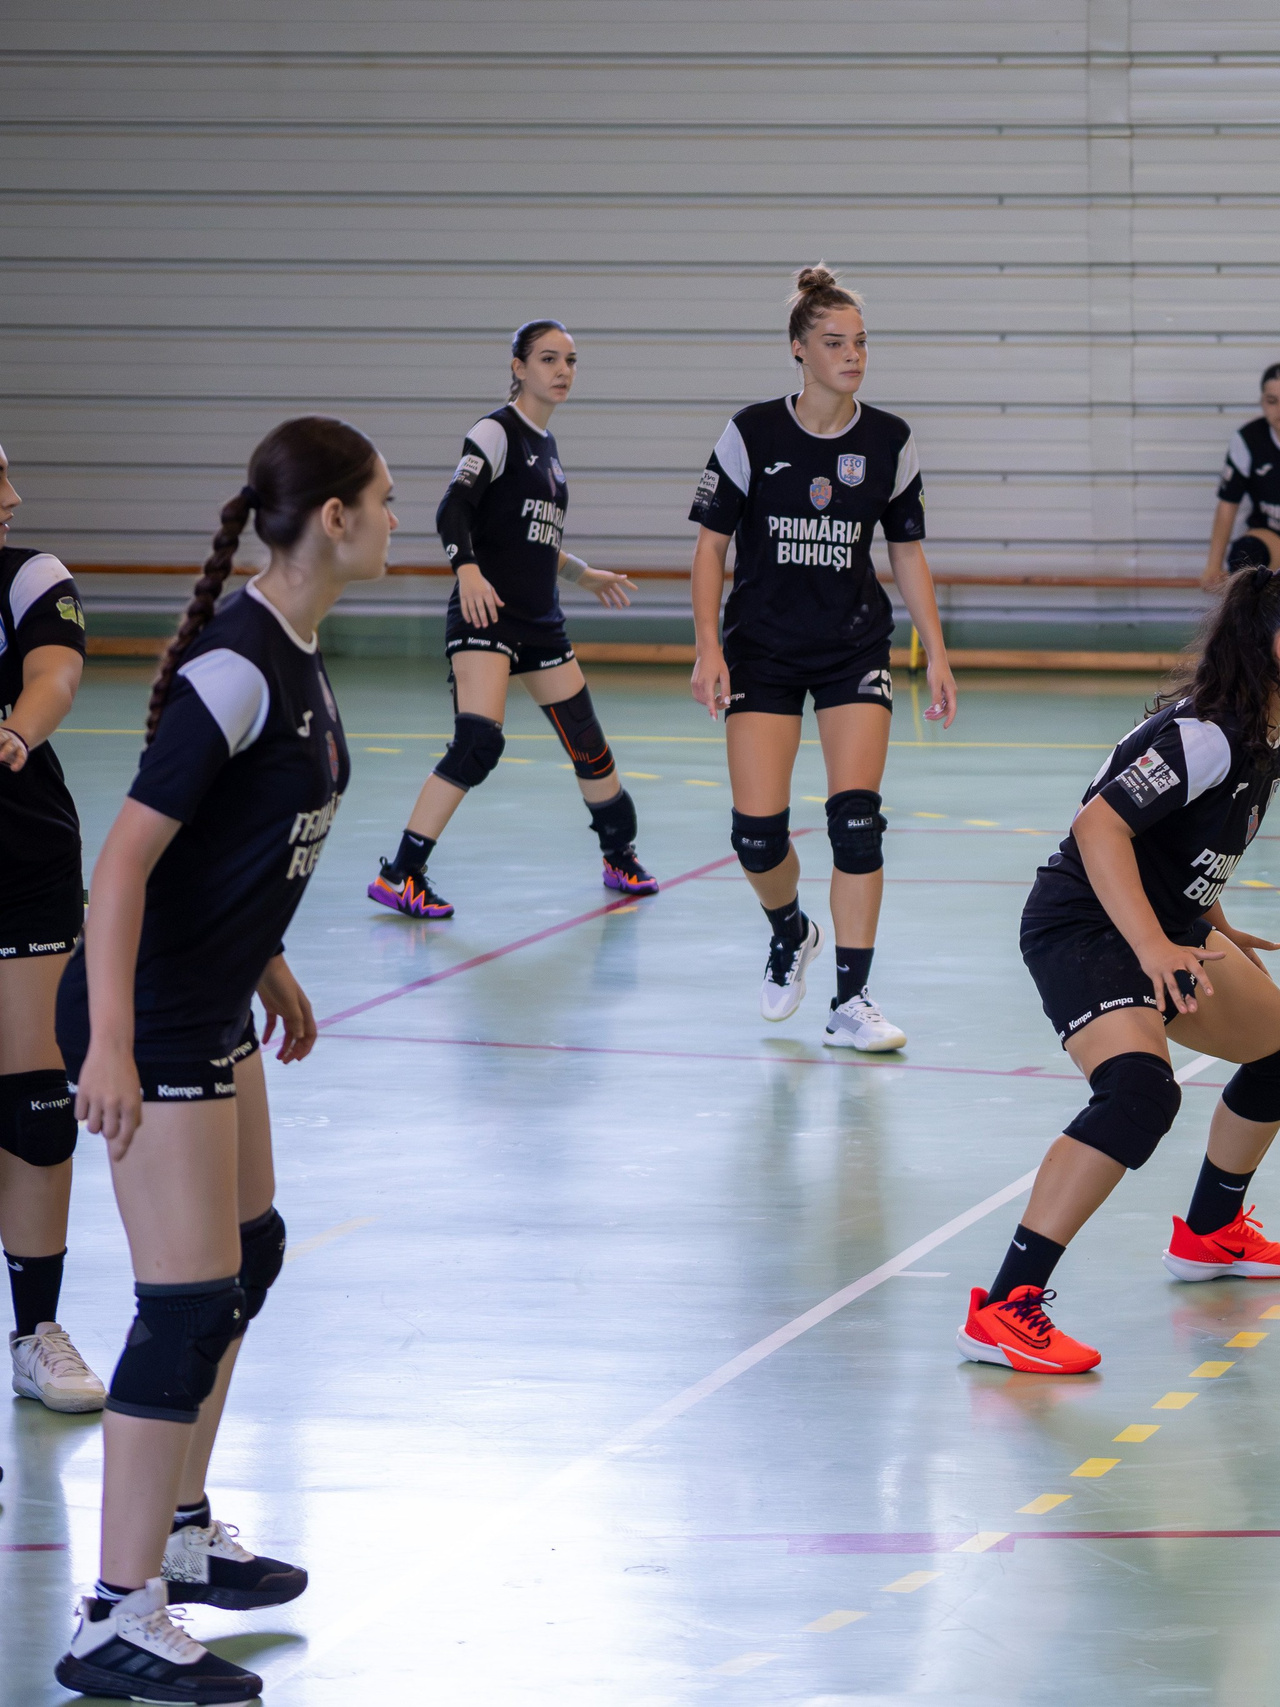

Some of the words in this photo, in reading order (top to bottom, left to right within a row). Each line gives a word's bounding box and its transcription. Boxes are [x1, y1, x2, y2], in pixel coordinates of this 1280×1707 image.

[768, 515, 861, 544] PRIMĂRIA
[777, 542, 852, 573] BUHUȘI
[29, 941, 66, 953] Kempa
[1069, 1010, 1092, 1031] Kempa
[1100, 997, 1134, 1011] Kempa
[157, 1084, 203, 1099] Kempa
